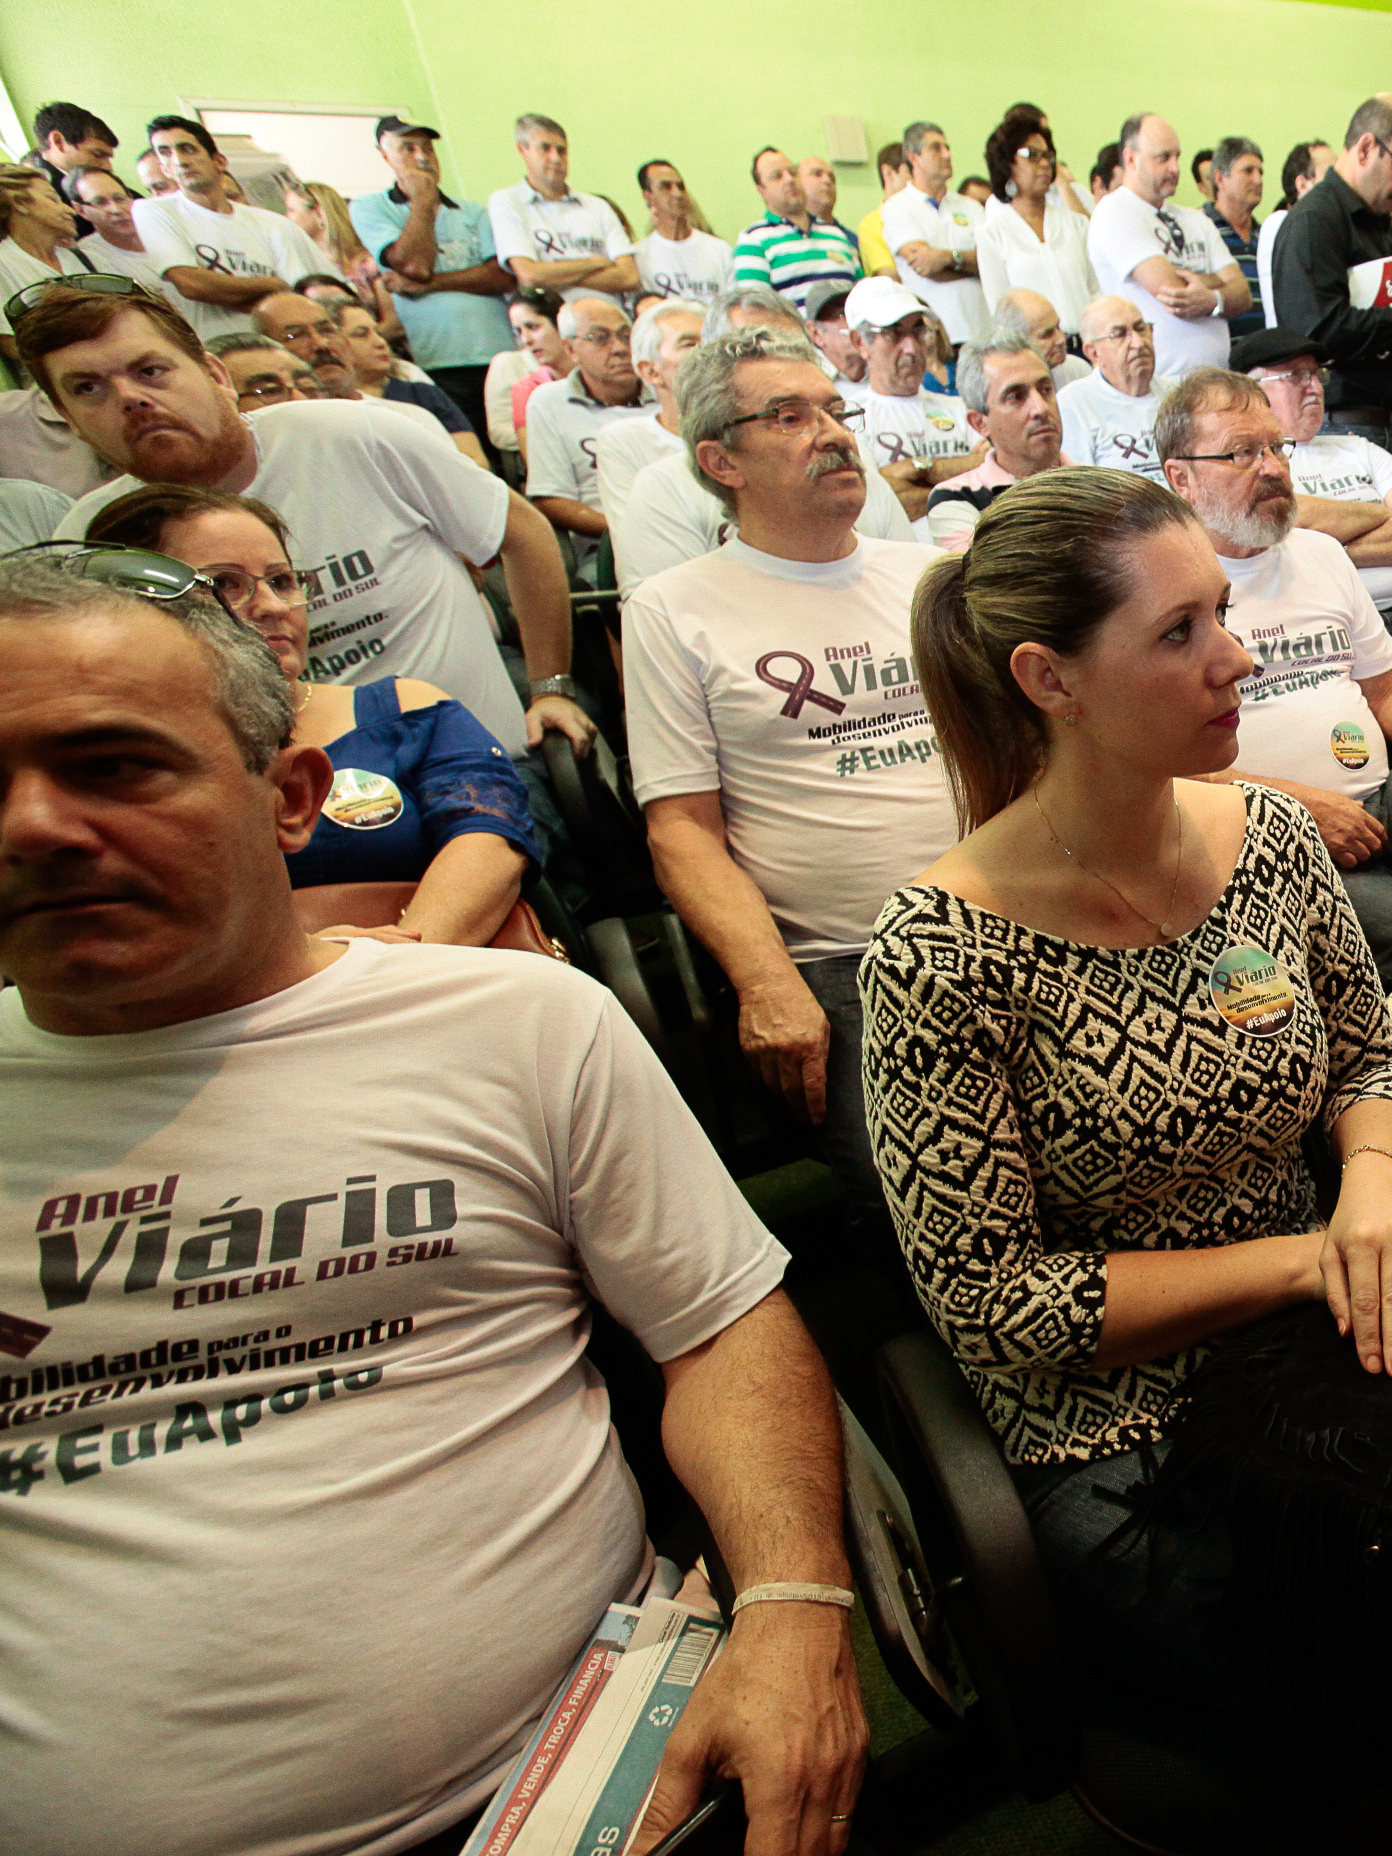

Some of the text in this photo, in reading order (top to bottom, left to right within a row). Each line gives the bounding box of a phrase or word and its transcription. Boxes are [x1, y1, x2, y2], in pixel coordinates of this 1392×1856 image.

[1251, 623, 1285, 640] Anel
[1257, 625, 1351, 664] Viário
[824, 641, 872, 662] Anel
[808, 711, 896, 740] Mobilidade
[899, 711, 917, 721] para
[1235, 966, 1277, 987] Viário
[1227, 994, 1260, 1010] Mobilidade
[1246, 1008, 1287, 1029] #EuApoio
[35, 1174, 180, 1232] Anel
[38, 1174, 458, 1311] Viário
[173, 1237, 460, 1310] COCAL DO SUL
[206, 1330, 270, 1356] para
[274, 1323, 292, 1338] o
[0, 1366, 383, 1497] #EuApoio
[517, 1749, 554, 1801] VENDE,
[543, 1707, 576, 1752] TROCA,
[568, 1651, 605, 1706] FINANCIA
